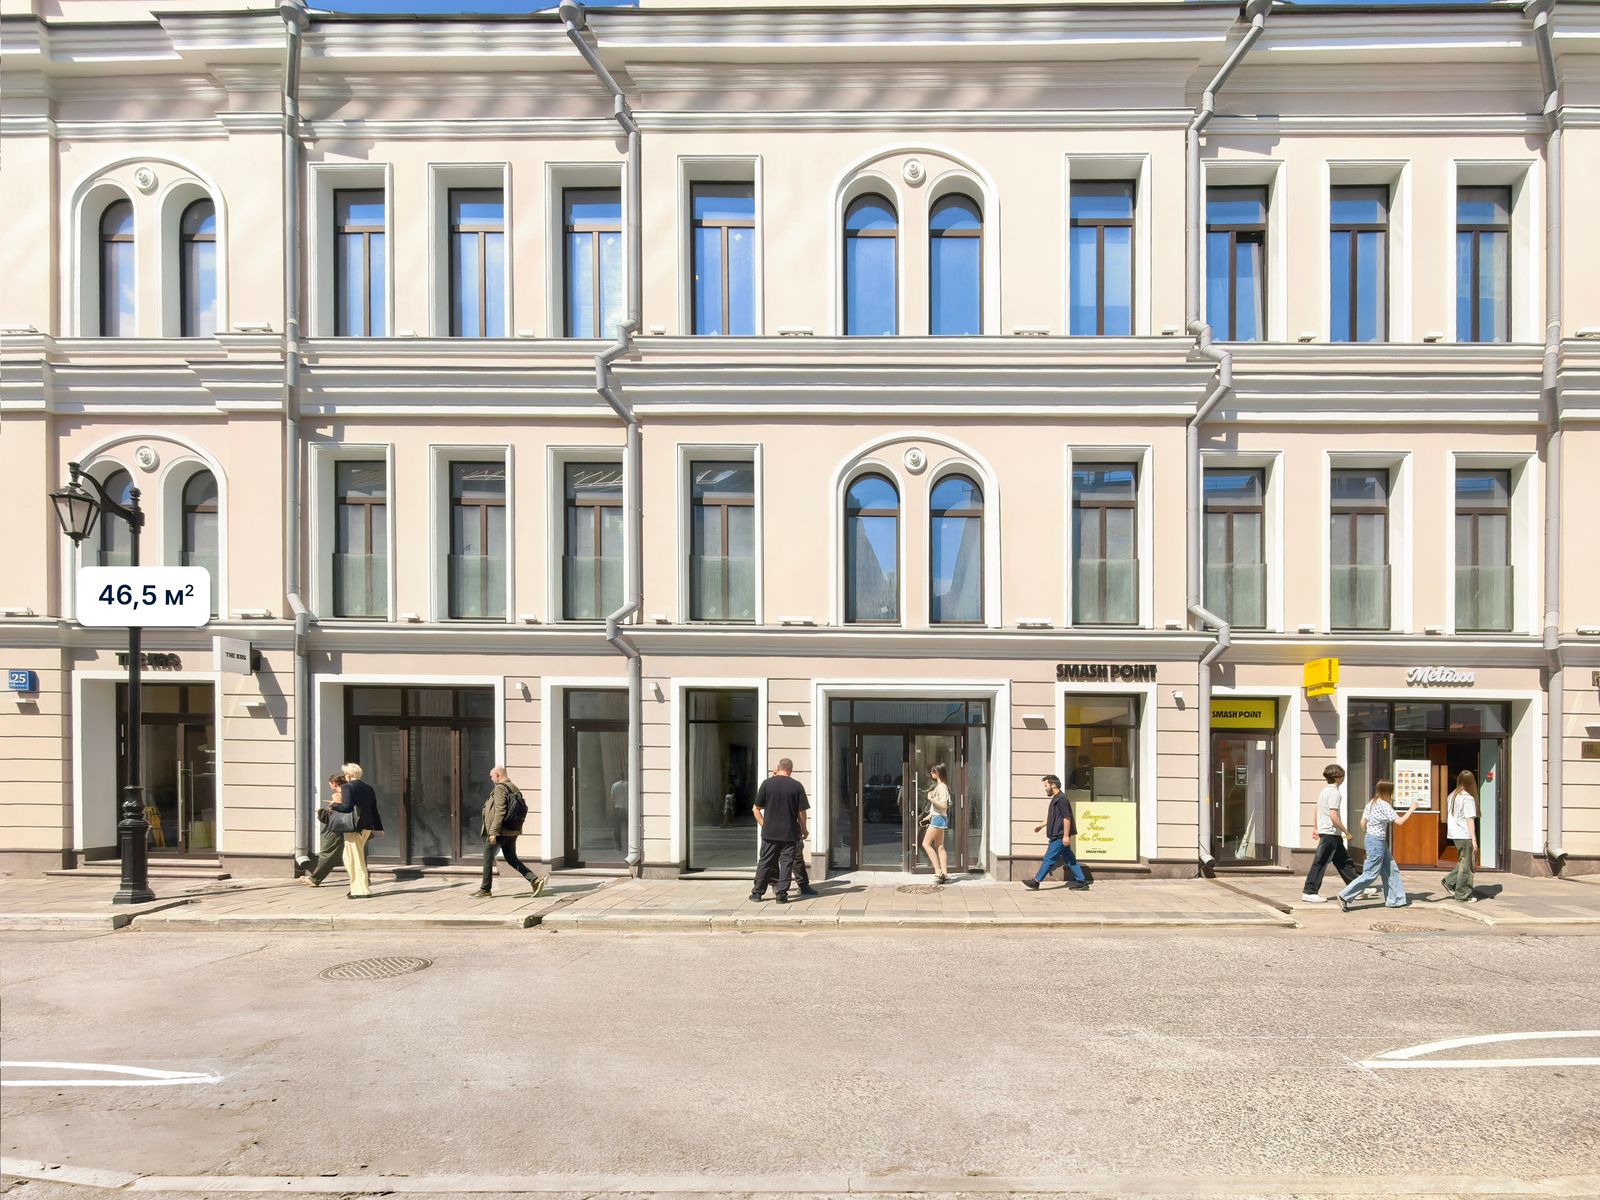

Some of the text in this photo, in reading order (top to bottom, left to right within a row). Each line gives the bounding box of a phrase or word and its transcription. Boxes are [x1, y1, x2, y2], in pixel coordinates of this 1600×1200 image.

[1056, 664, 1108, 678] SMASH
[11, 673, 27, 684] 25
[1211, 710, 1238, 718] SMASH
